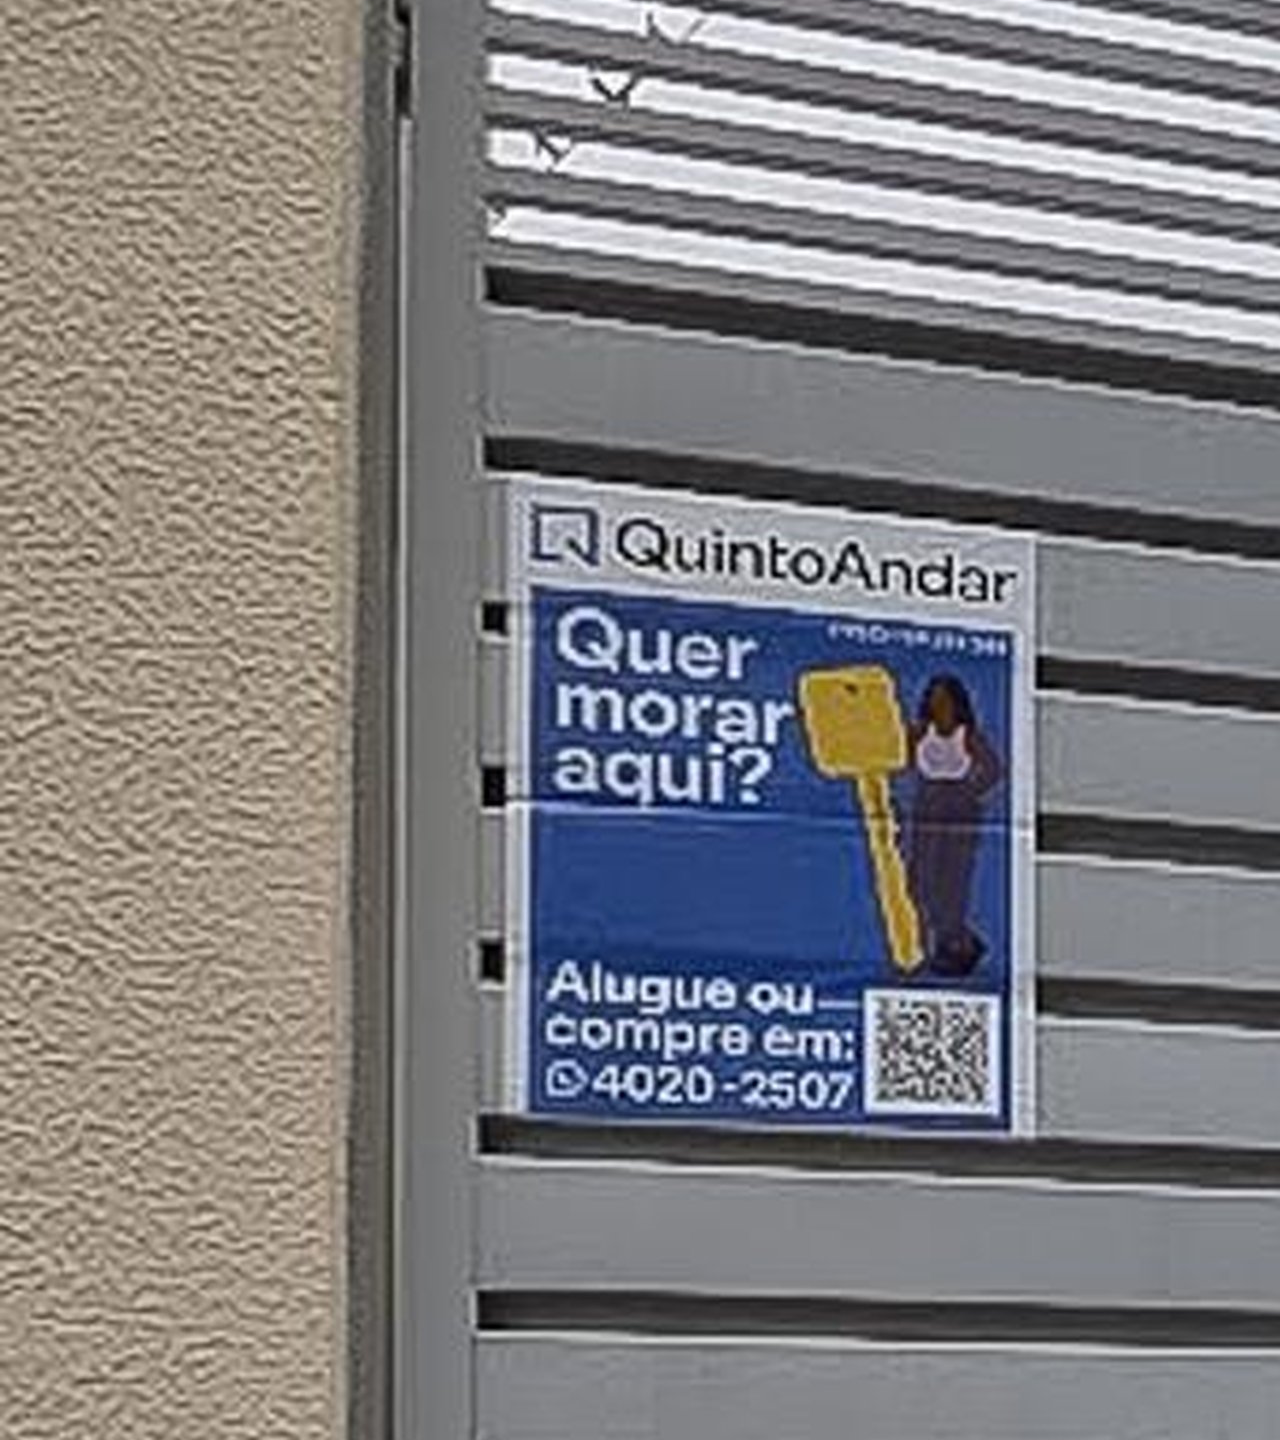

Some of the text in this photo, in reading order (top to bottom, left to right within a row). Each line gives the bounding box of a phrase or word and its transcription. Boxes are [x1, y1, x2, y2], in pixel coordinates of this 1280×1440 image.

[615, 518, 1018, 602] QuintoAndar
[557, 607, 759, 680] Quer
[557, 683, 794, 744] morar
[555, 742, 772, 807] aqui?
[546, 960, 814, 1015] Alugue ou
[546, 1015, 855, 1061] compre em:
